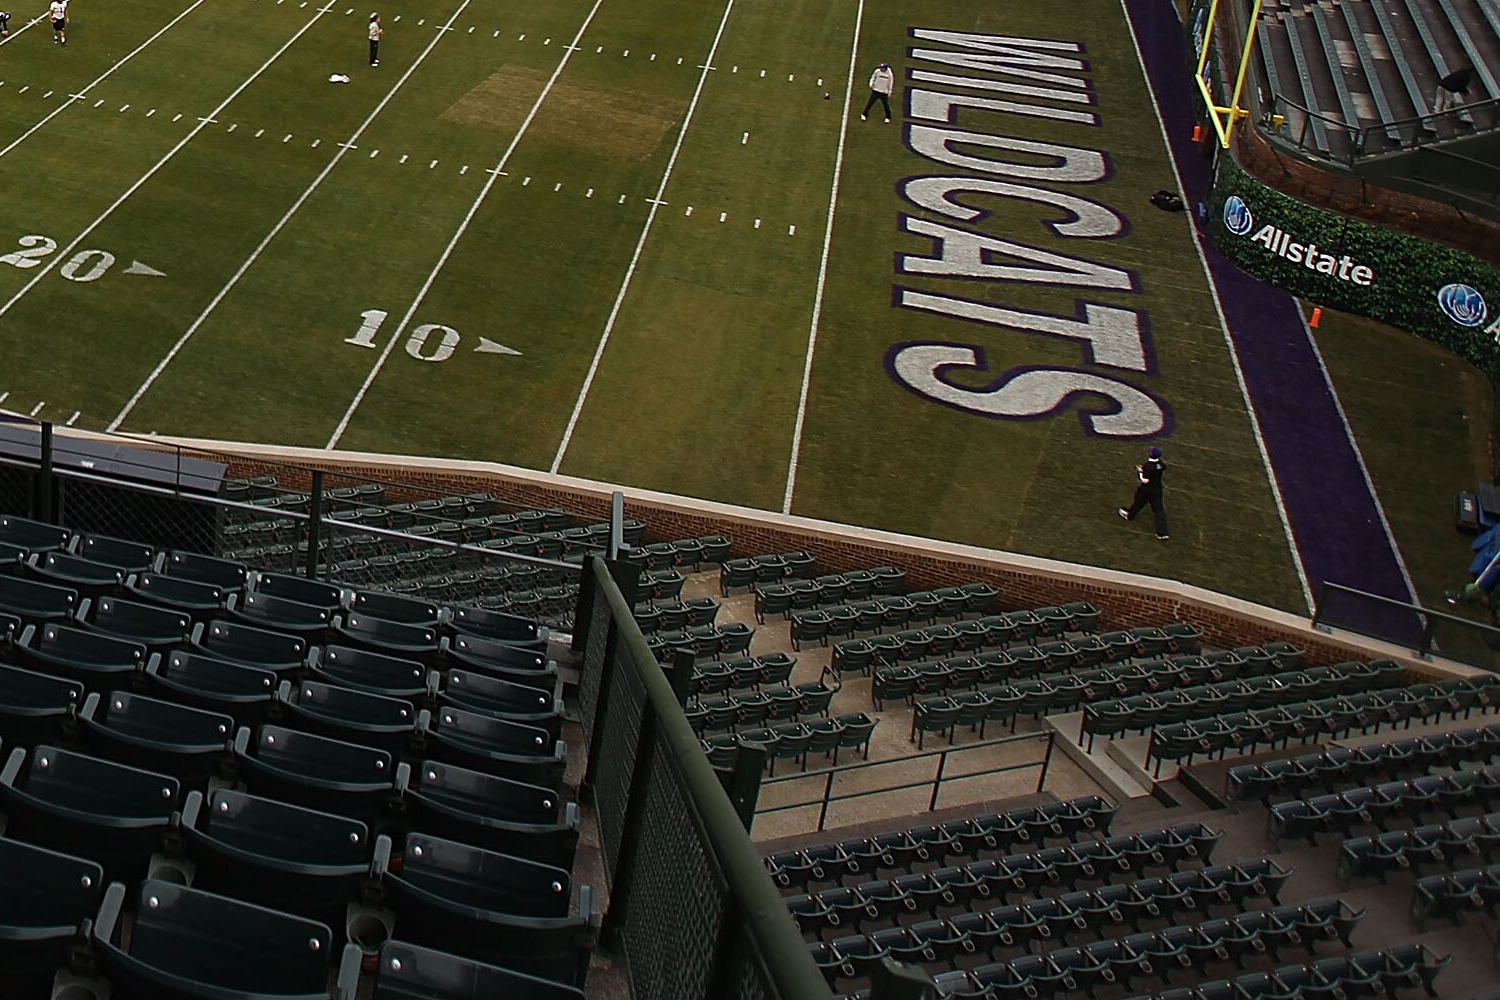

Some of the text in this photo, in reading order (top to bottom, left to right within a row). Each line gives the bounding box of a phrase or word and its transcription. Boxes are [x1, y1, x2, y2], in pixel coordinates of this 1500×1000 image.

[884, 26, 1175, 440] WILDCATS
[1250, 224, 1375, 286] Allstate
[344, 309, 461, 362] 10
